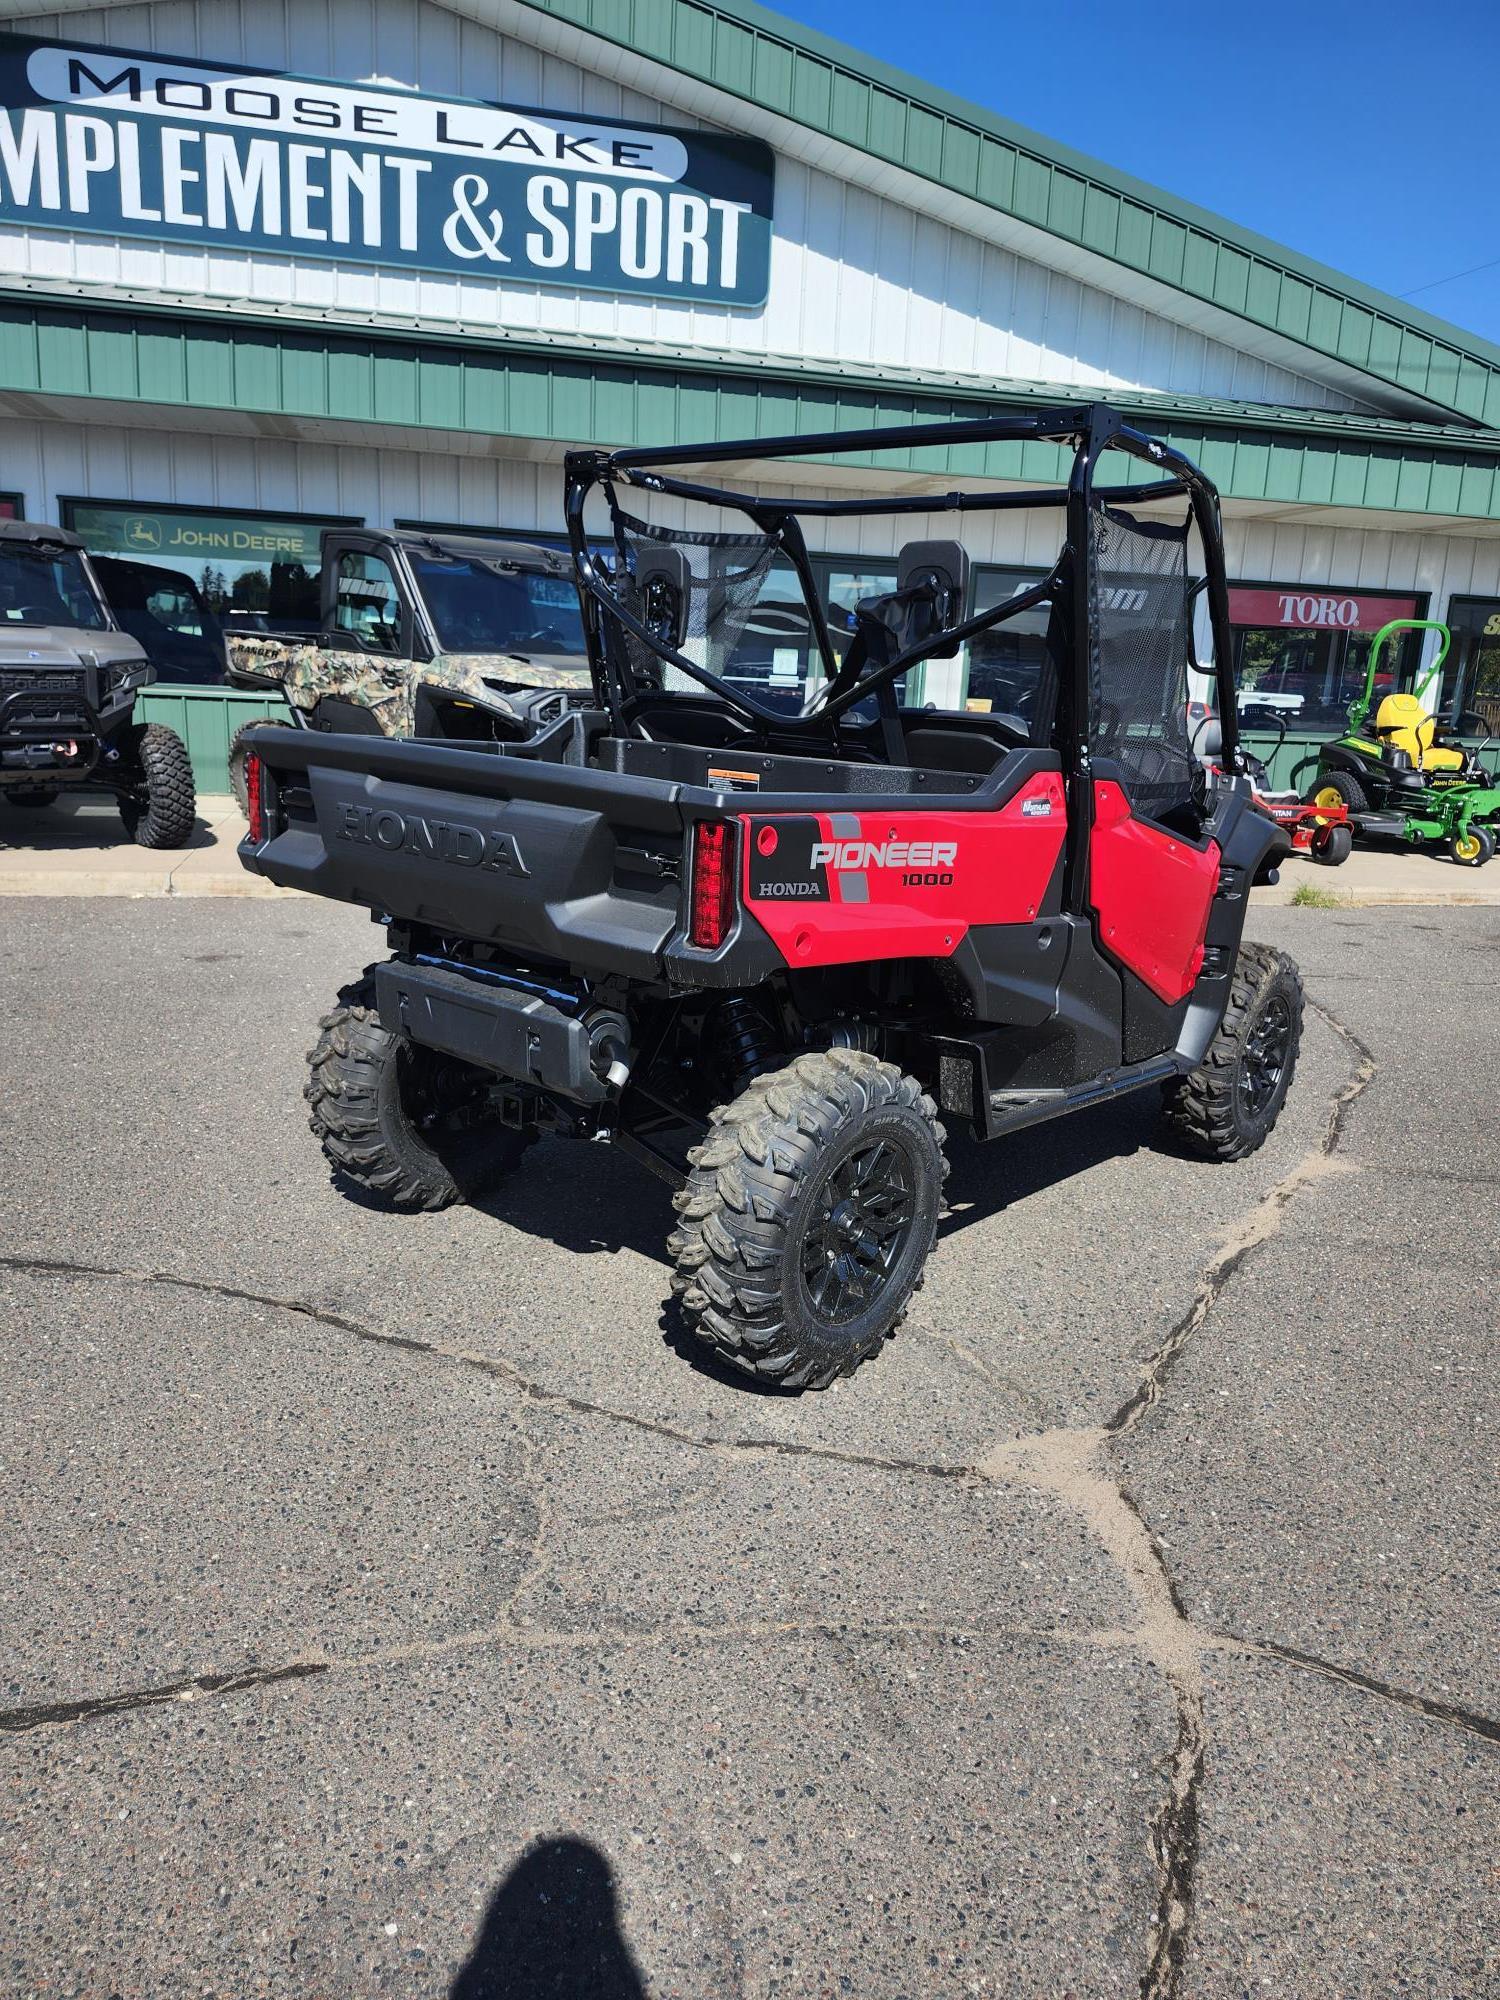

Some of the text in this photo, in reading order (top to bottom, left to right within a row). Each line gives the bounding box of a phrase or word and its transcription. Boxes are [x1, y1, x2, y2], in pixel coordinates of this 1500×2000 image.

[68, 58, 654, 171] MOOSE LAKE
[0, 106, 752, 289] MPLEMENT & SPORT
[170, 527, 304, 552] JOHN DEERE
[238, 644, 279, 658] RANGER
[1, 679, 79, 690] POLARIS
[336, 802, 532, 879] HONDA
[810, 842, 957, 869] PIONEER
[759, 882, 821, 897] HONDA
[902, 873, 954, 887] 1000
